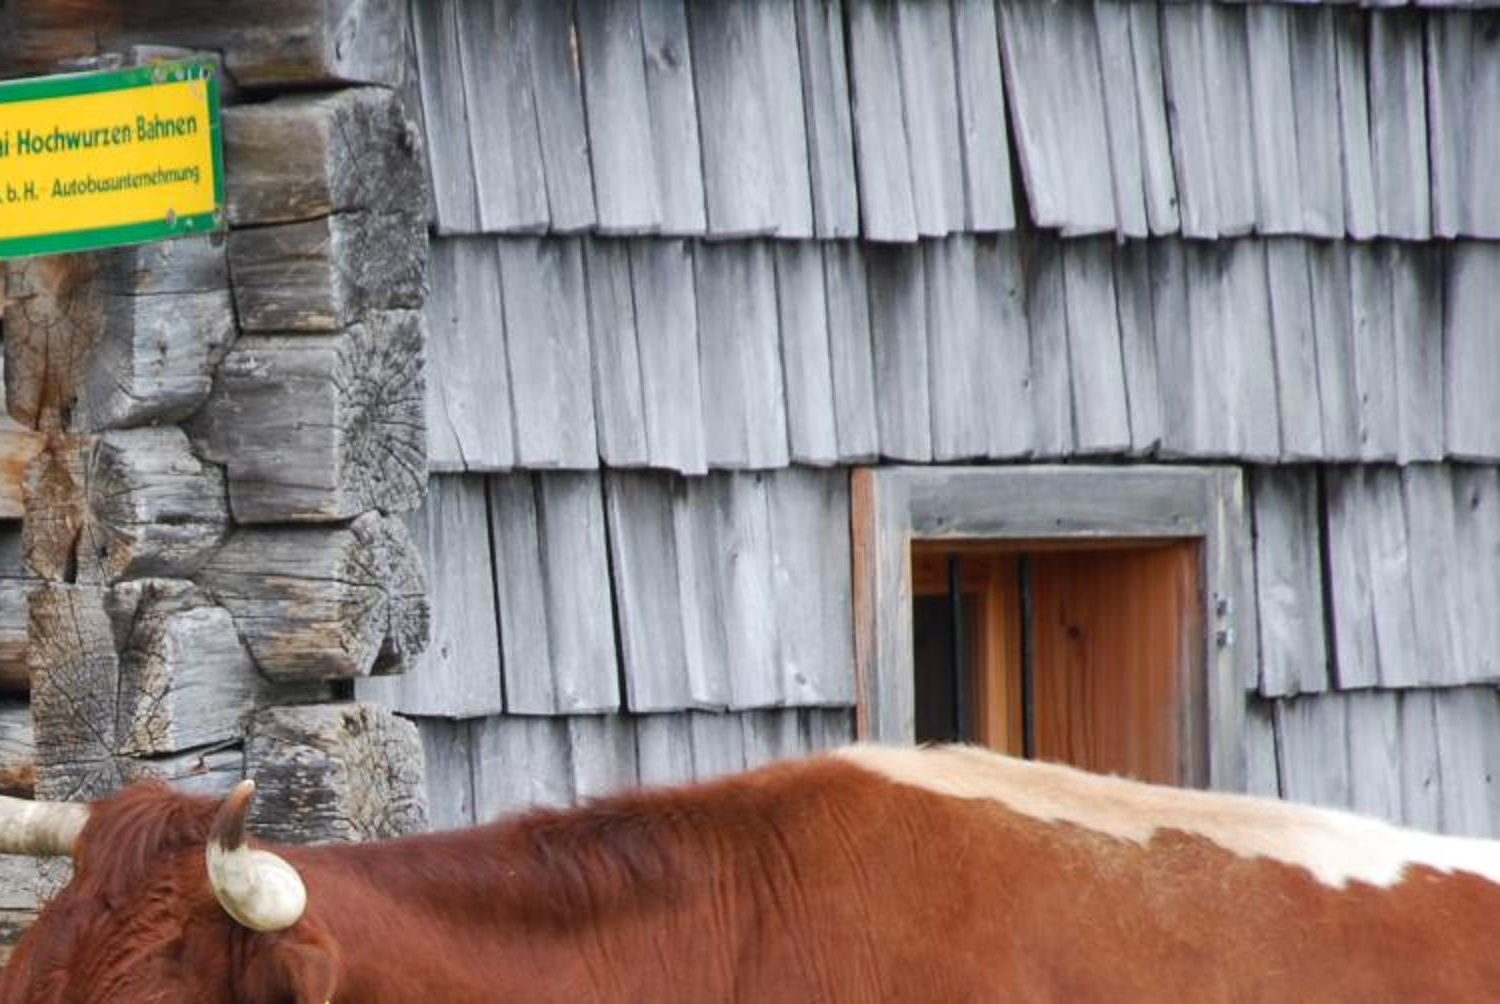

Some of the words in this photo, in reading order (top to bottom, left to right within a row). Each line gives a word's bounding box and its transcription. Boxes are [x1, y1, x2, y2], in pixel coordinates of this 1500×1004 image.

[17, 124, 132, 155] Hochwurzen
[136, 114, 197, 141] Bahnen
[7, 183, 21, 202] b.
[23, 180, 38, 200] H.
[51, 161, 200, 198] Autobusunternehmung
